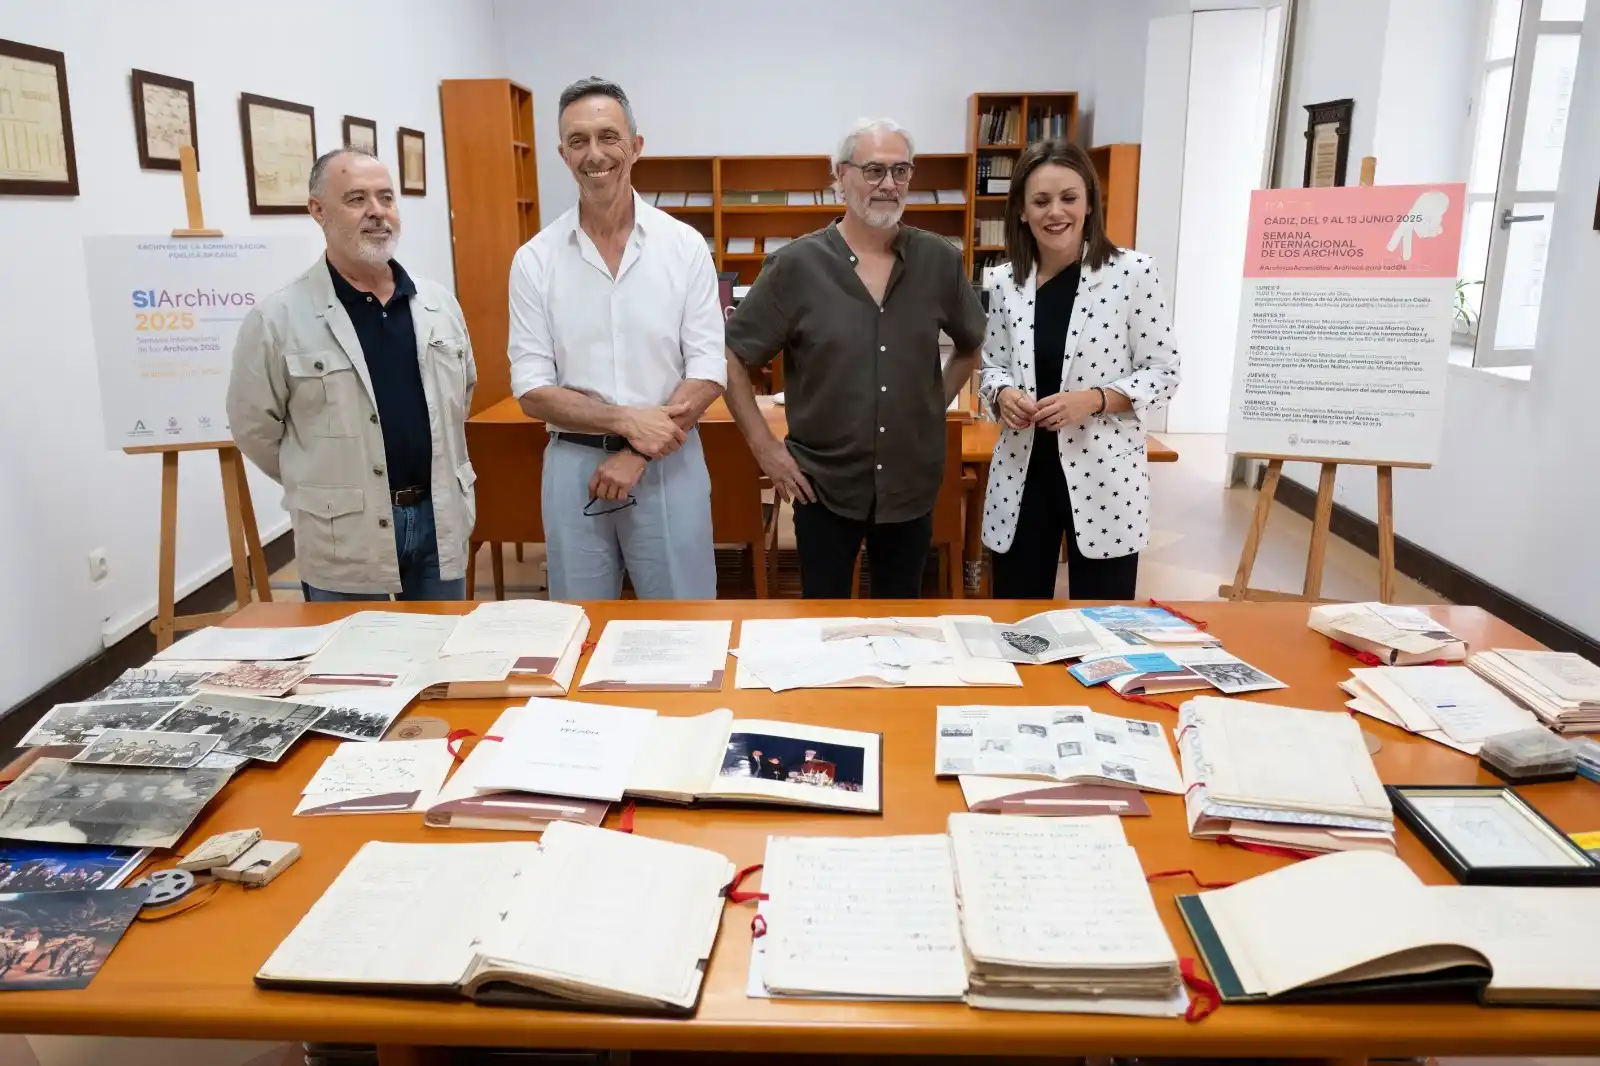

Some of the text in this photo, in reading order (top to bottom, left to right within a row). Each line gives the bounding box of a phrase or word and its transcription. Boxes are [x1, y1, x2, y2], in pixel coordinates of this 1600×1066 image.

[1264, 217, 1298, 226] CÁDIZ,
[1300, 217, 1318, 225] DEL
[1323, 216, 1328, 224] 9
[1360, 215, 1394, 224] JUNIO
[1396, 214, 1423, 223] 2025
[1262, 231, 1311, 240] SEMANA
[1262, 240, 1356, 249] INTERNACIONAL
[1278, 249, 1300, 258] LOS
[1302, 249, 1364, 258] ARCHIVOS
[132, 288, 256, 308] SIArchivos
[135, 312, 194, 331] 2025
